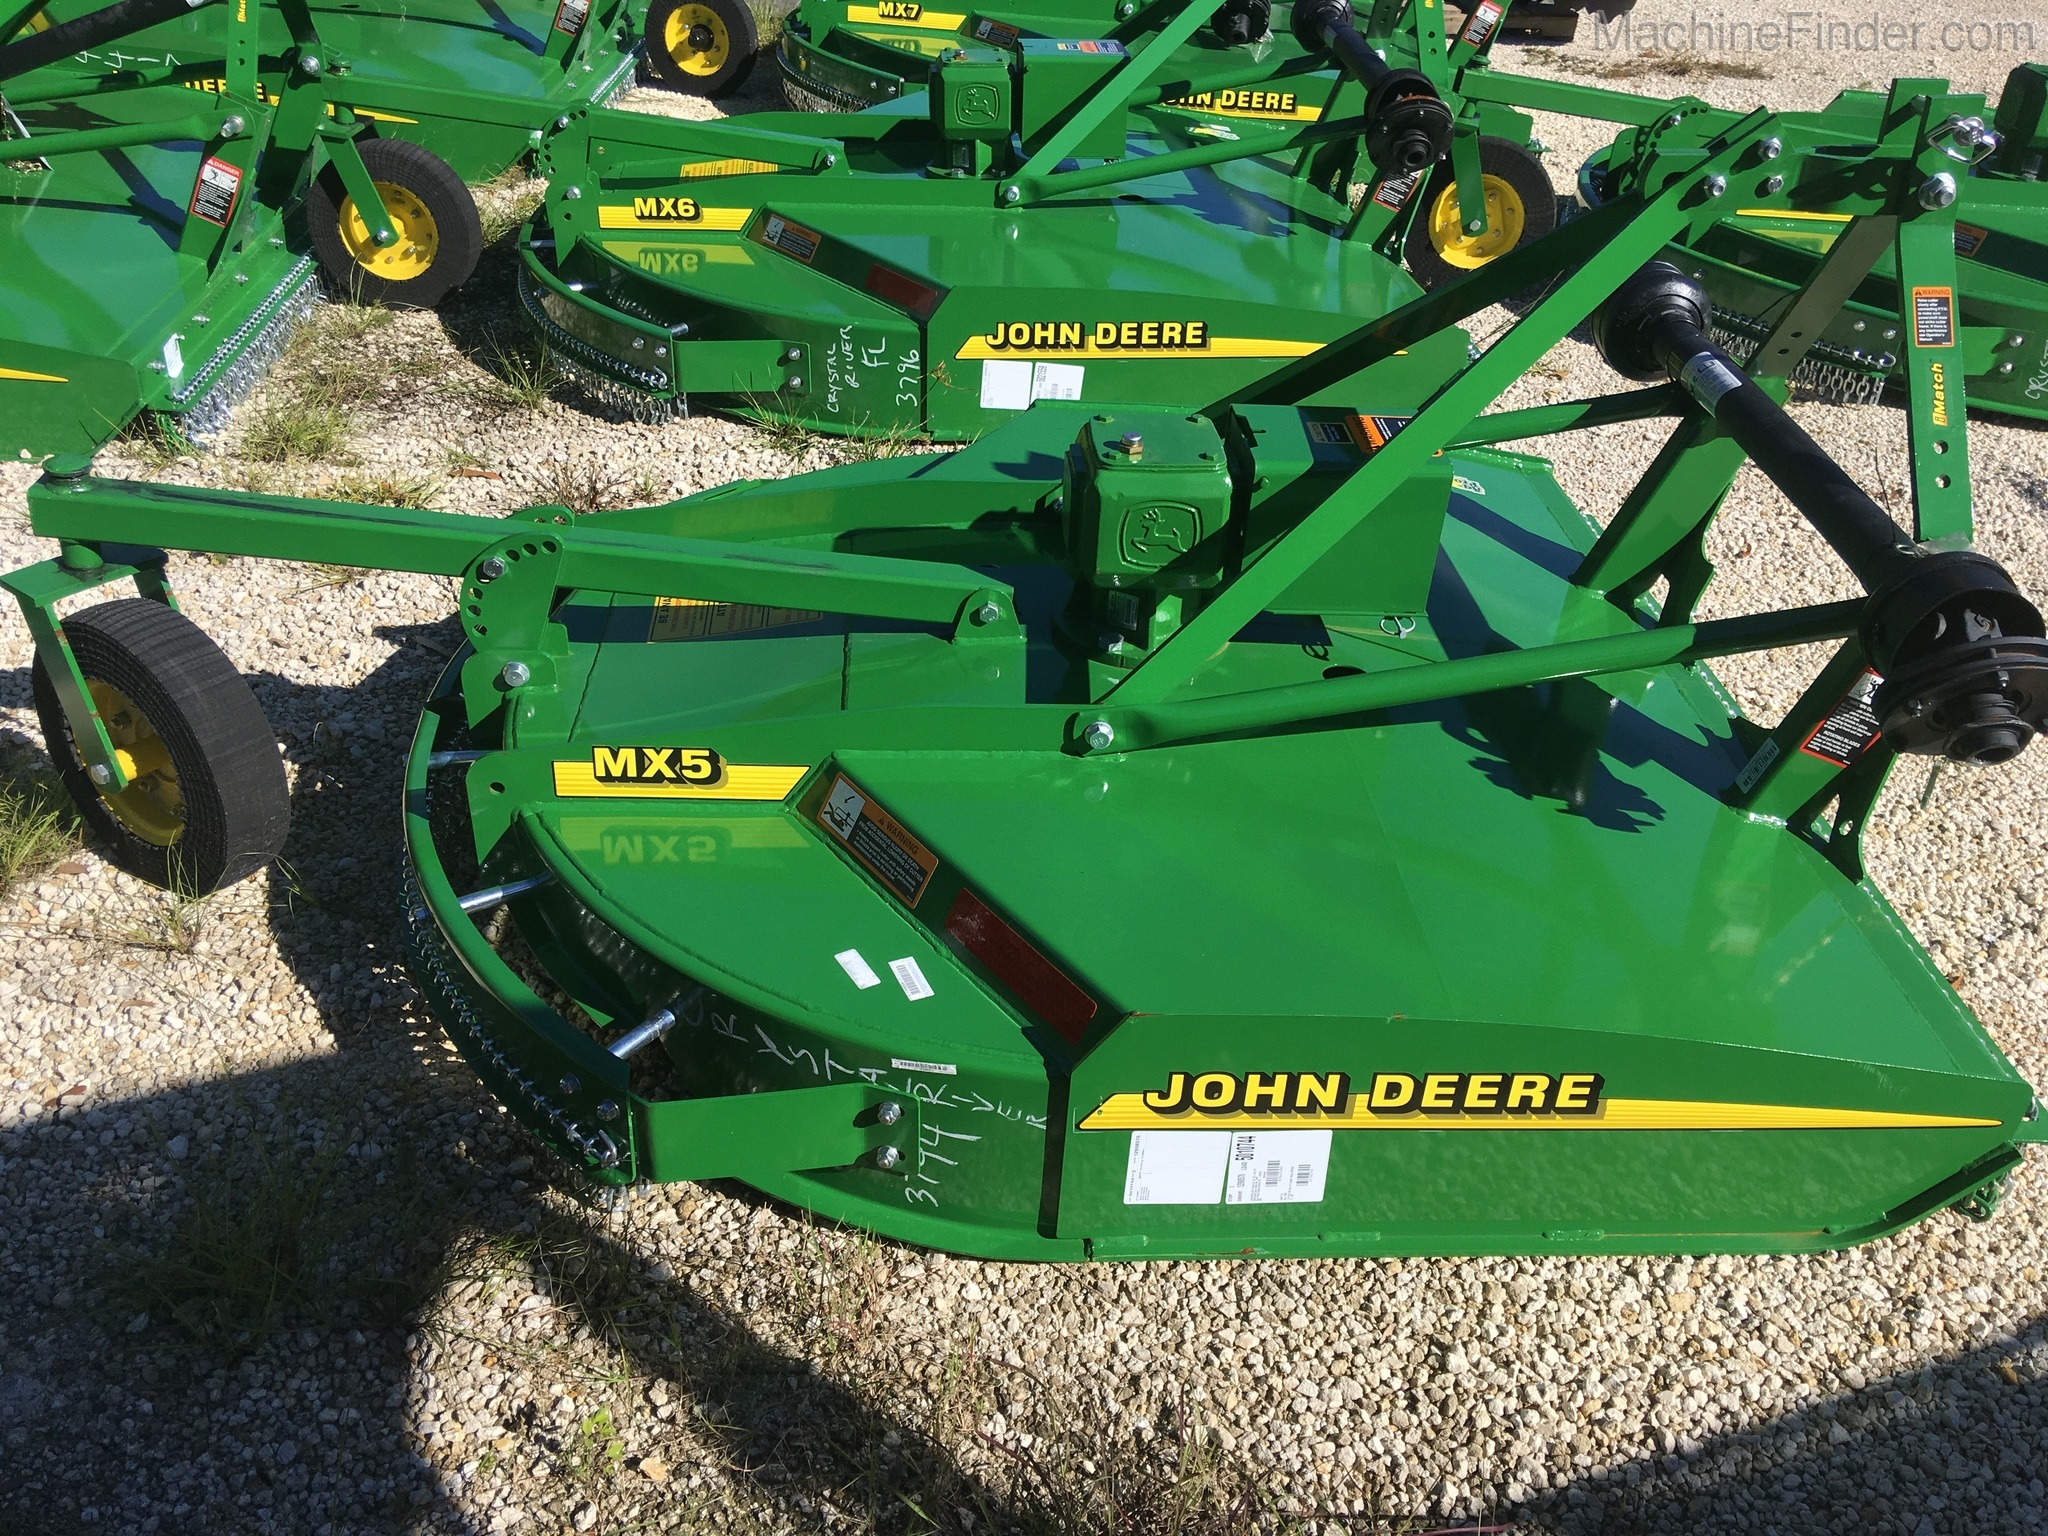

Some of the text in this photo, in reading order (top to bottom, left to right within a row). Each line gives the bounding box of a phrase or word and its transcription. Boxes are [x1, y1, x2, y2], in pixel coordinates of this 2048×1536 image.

[878, 1, 923, 20] MX7
[1220, 89, 1297, 111] DEERE
[213, 161, 240, 176] DANGER
[633, 197, 700, 221] MX6
[861, 336, 890, 368] FL
[985, 320, 1209, 349] JOHN DEERE
[840, 325, 859, 389] RIVER
[827, 343, 839, 413] CRYSTAL
[896, 349, 921, 407] 3796
[1931, 362, 1948, 426] iMatch
[592, 746, 724, 785] MX5
[885, 820, 919, 856] WARNING
[1143, 1072, 1605, 1115] JOHN DEERE
